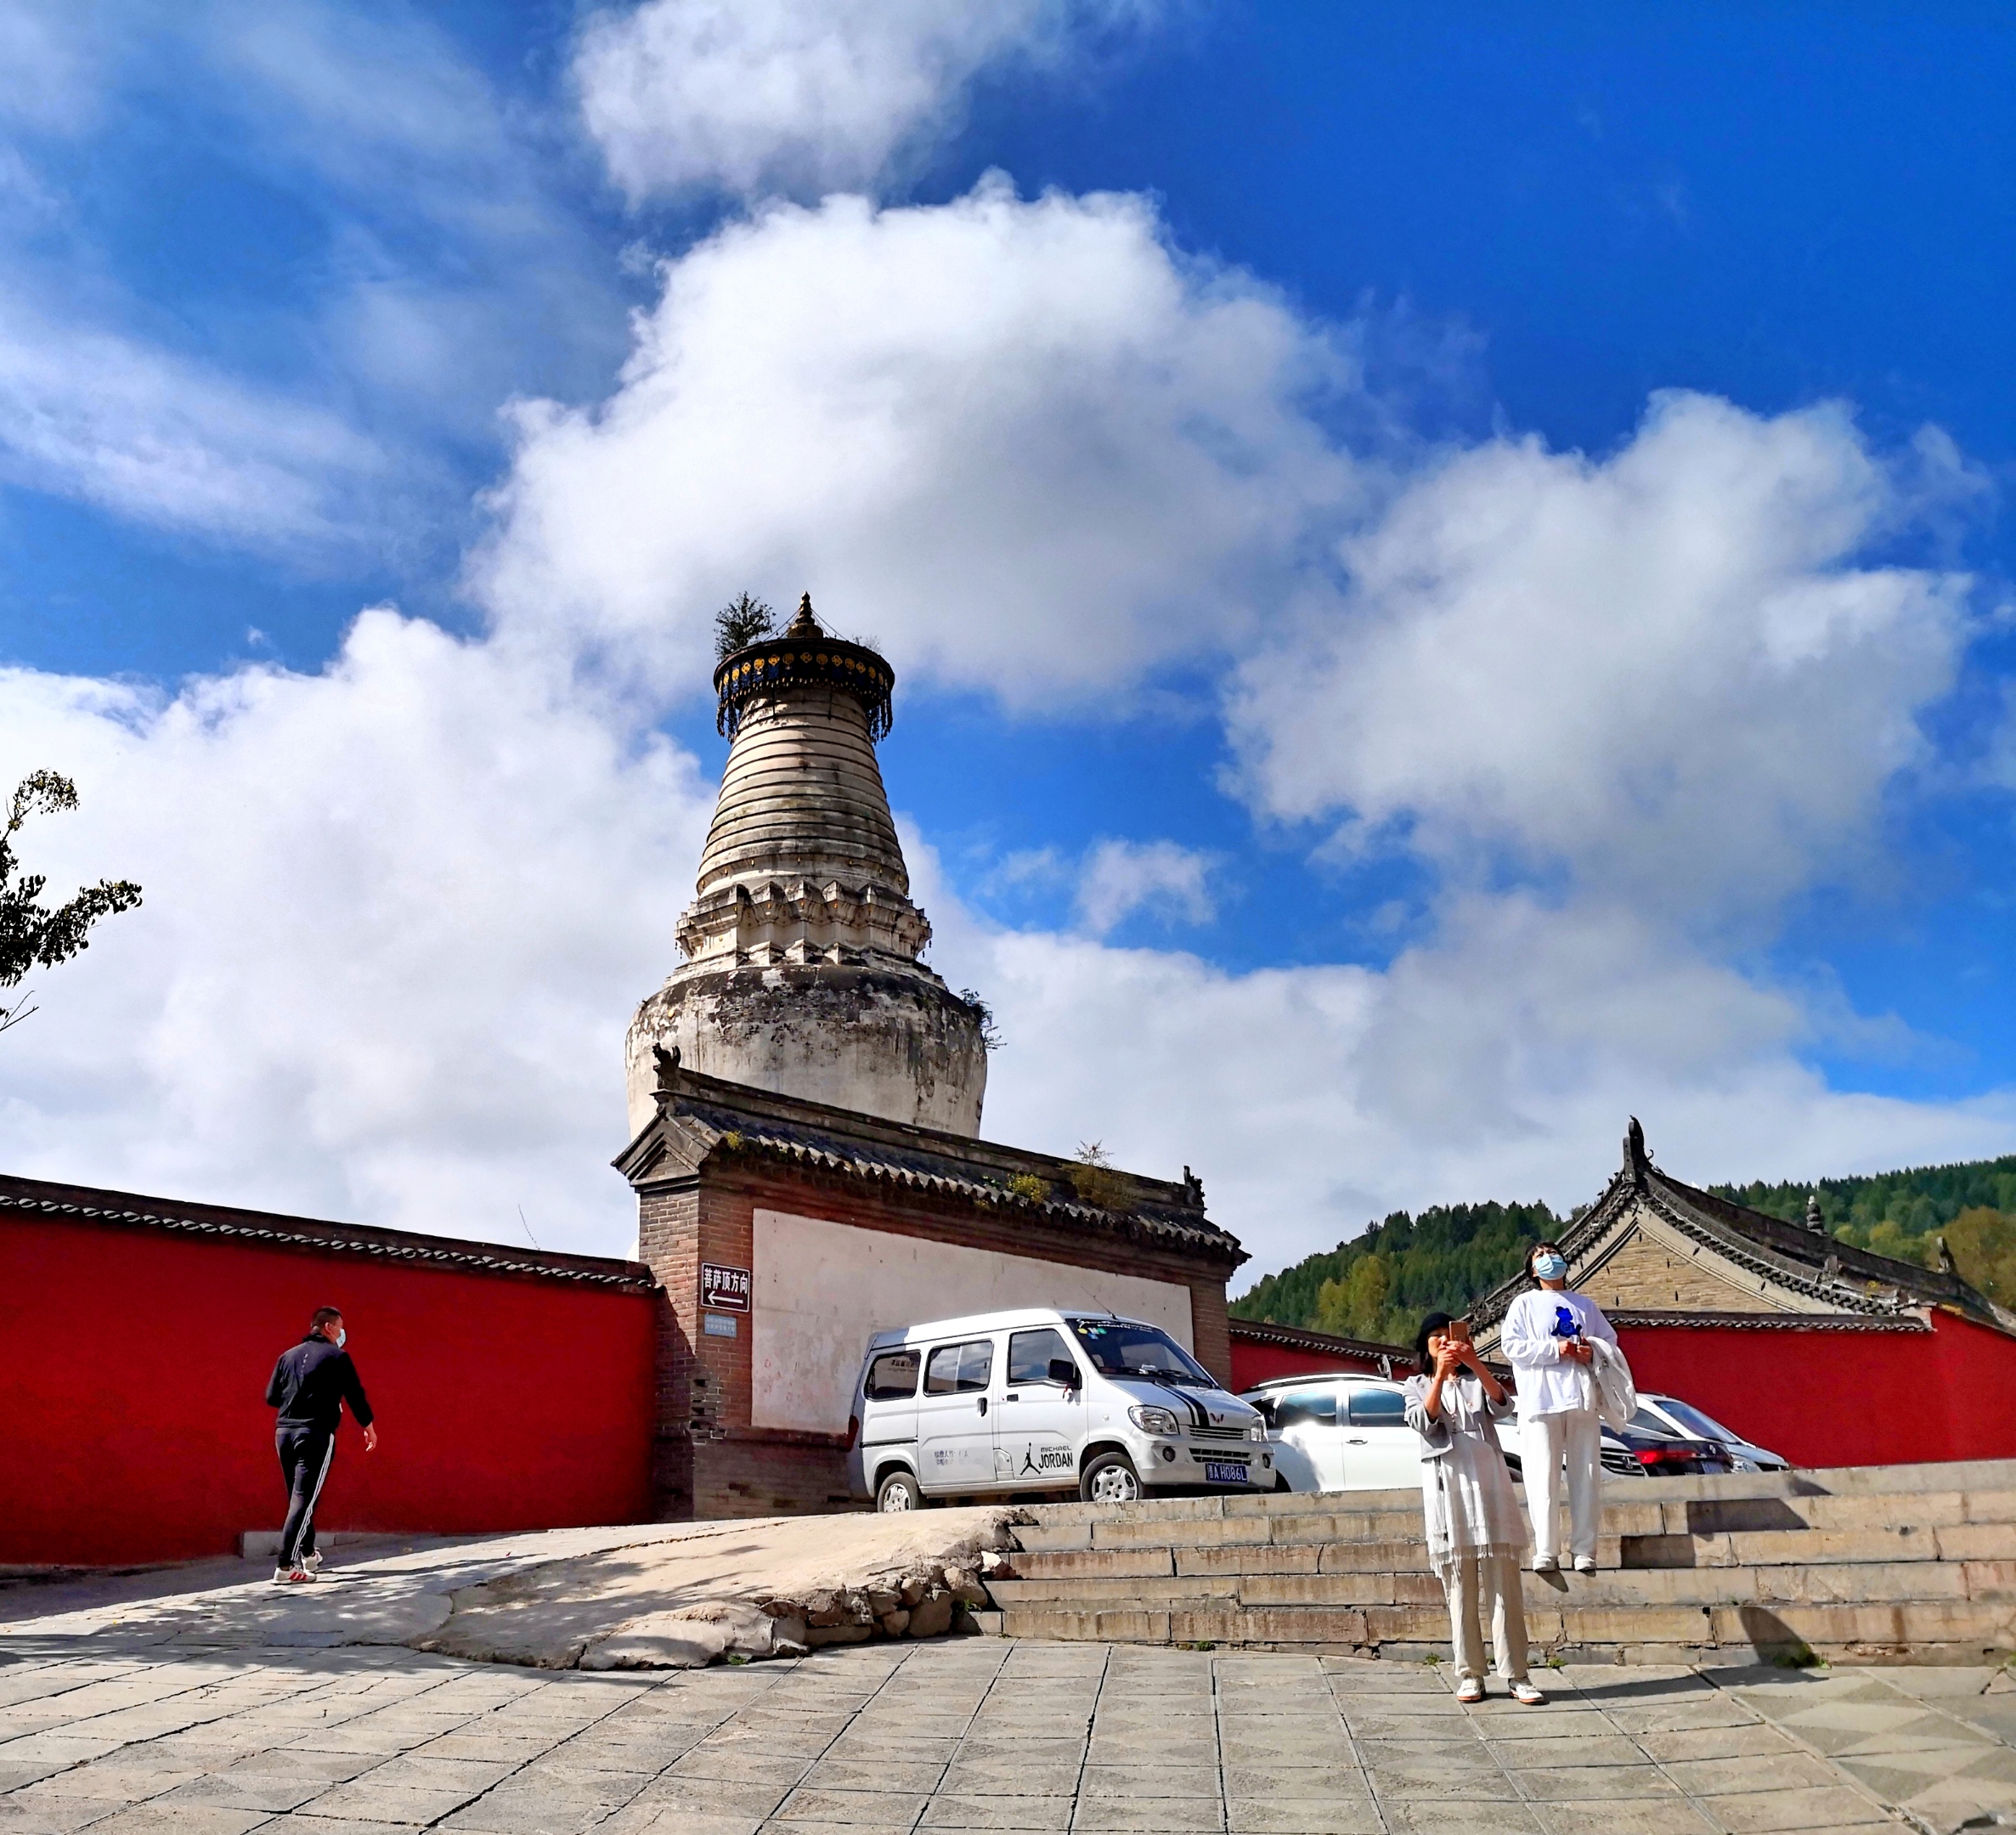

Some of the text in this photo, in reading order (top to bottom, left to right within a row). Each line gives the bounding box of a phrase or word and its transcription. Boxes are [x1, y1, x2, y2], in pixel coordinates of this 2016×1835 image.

[704, 1267, 748, 1295] 菩萨顶方向
[1038, 1452, 1073, 1469] JORDAN
